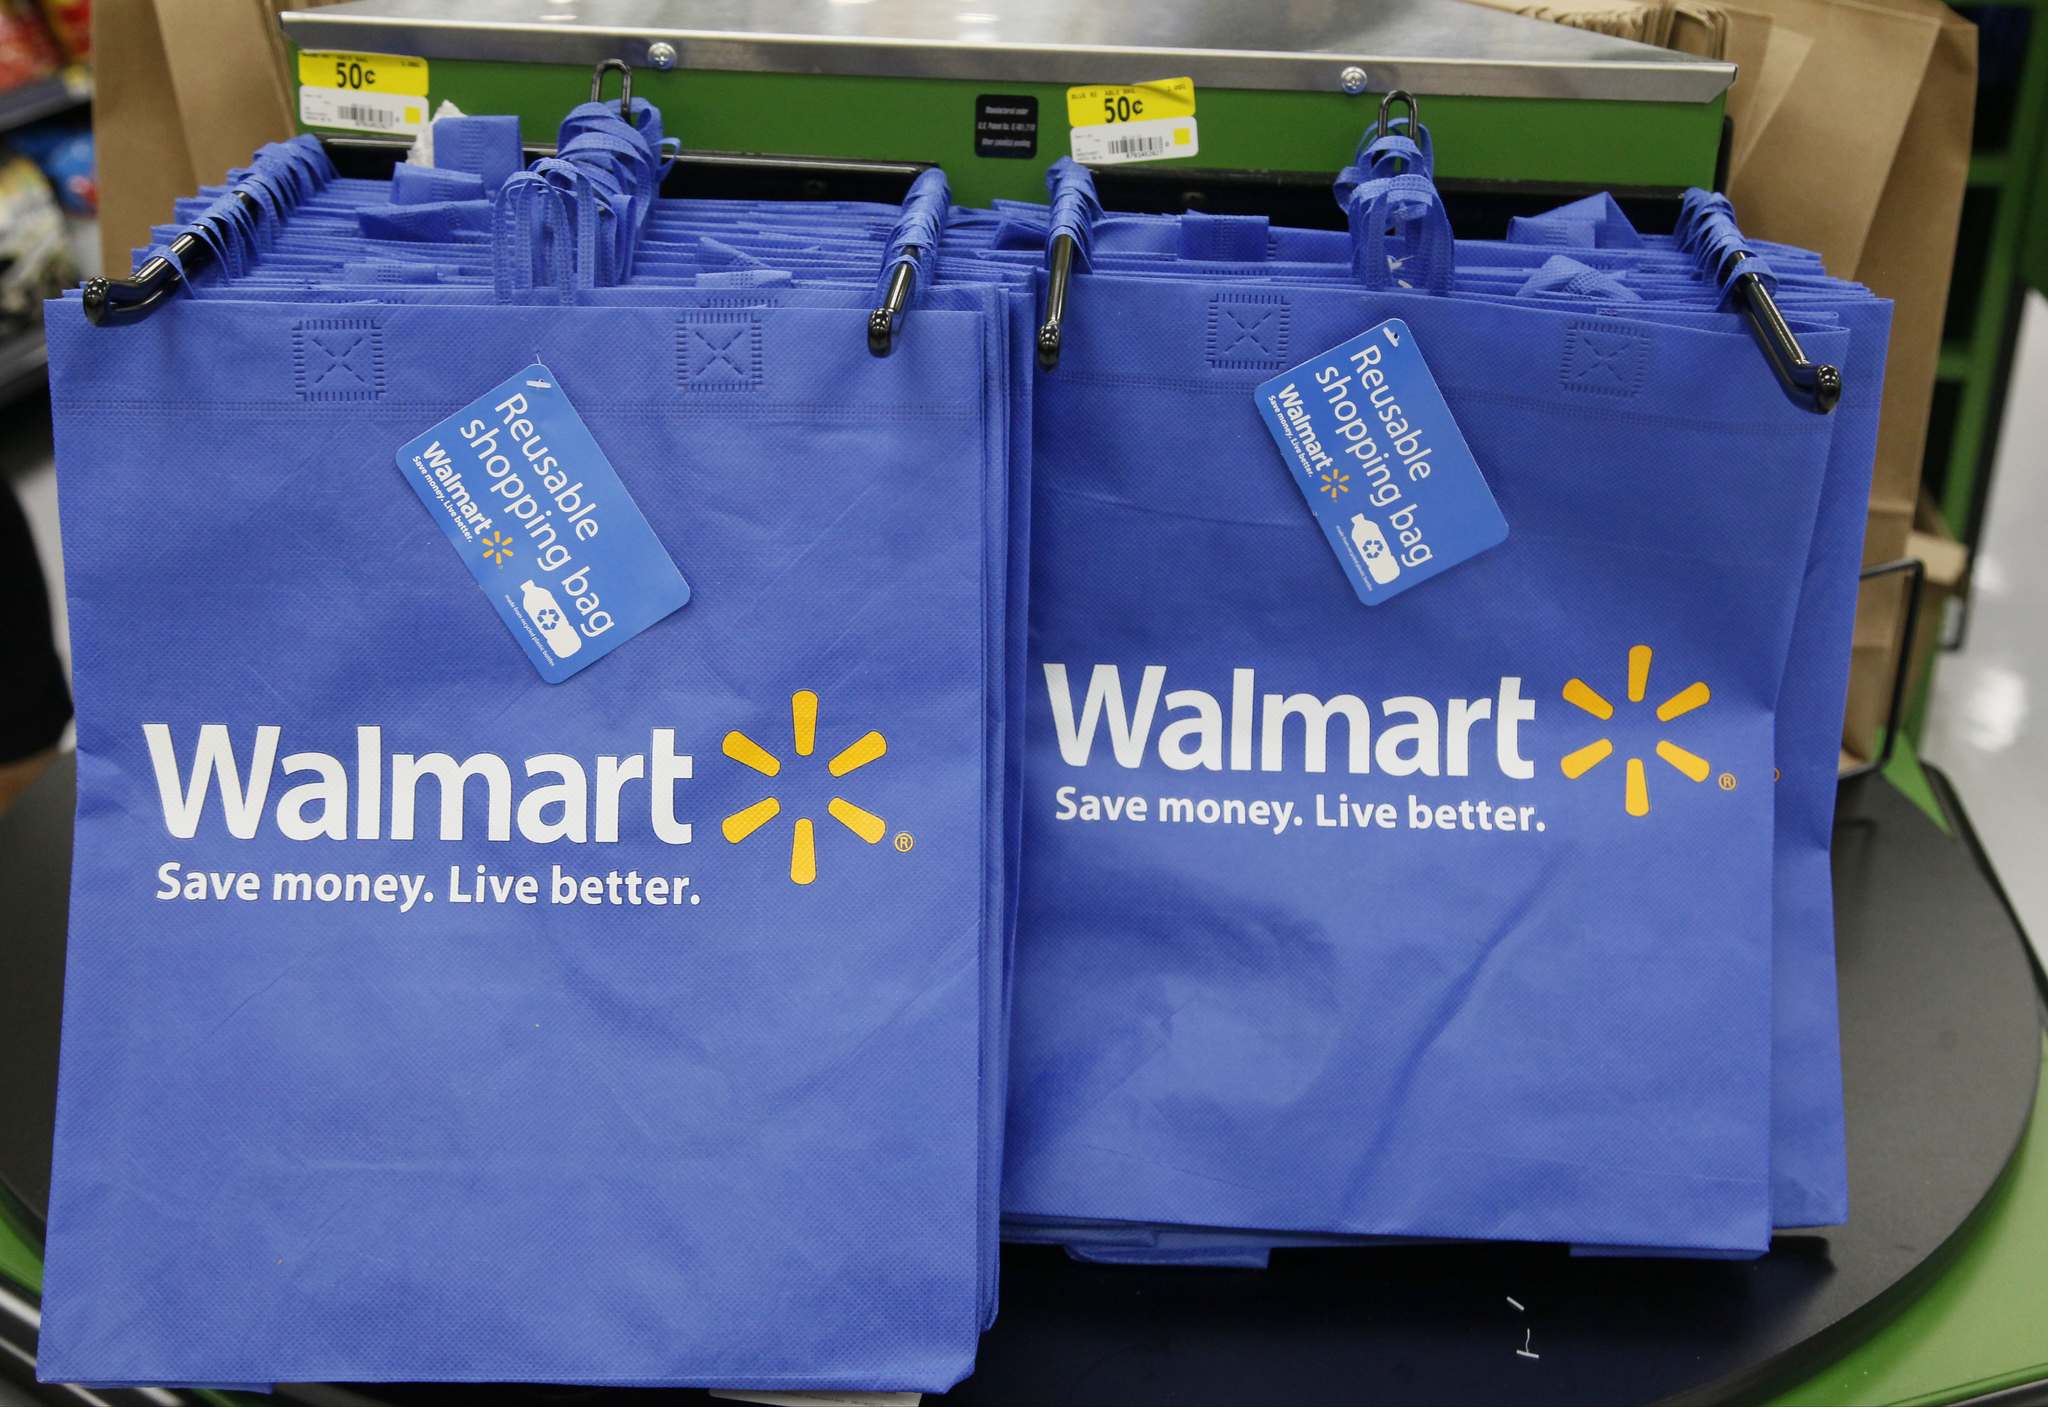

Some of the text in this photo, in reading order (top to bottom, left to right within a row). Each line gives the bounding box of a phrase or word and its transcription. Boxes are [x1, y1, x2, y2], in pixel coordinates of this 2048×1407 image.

[1267, 394, 1313, 478] Save money. Live better.
[1279, 384, 1332, 470] Walmart
[1350, 345, 1431, 480] Reusable
[412, 455, 473, 543] Save money. Live better.
[424, 441, 492, 534] Walmart
[495, 393, 598, 540] Reusable
[1315, 367, 1432, 566] shopping bag
[460, 420, 614, 636] shopping bag
[1044, 664, 1535, 779] Walmart
[143, 724, 692, 844] Walmart
[1056, 787, 1545, 834] Save money. Live better.
[157, 862, 700, 912] Save money. Live better.
